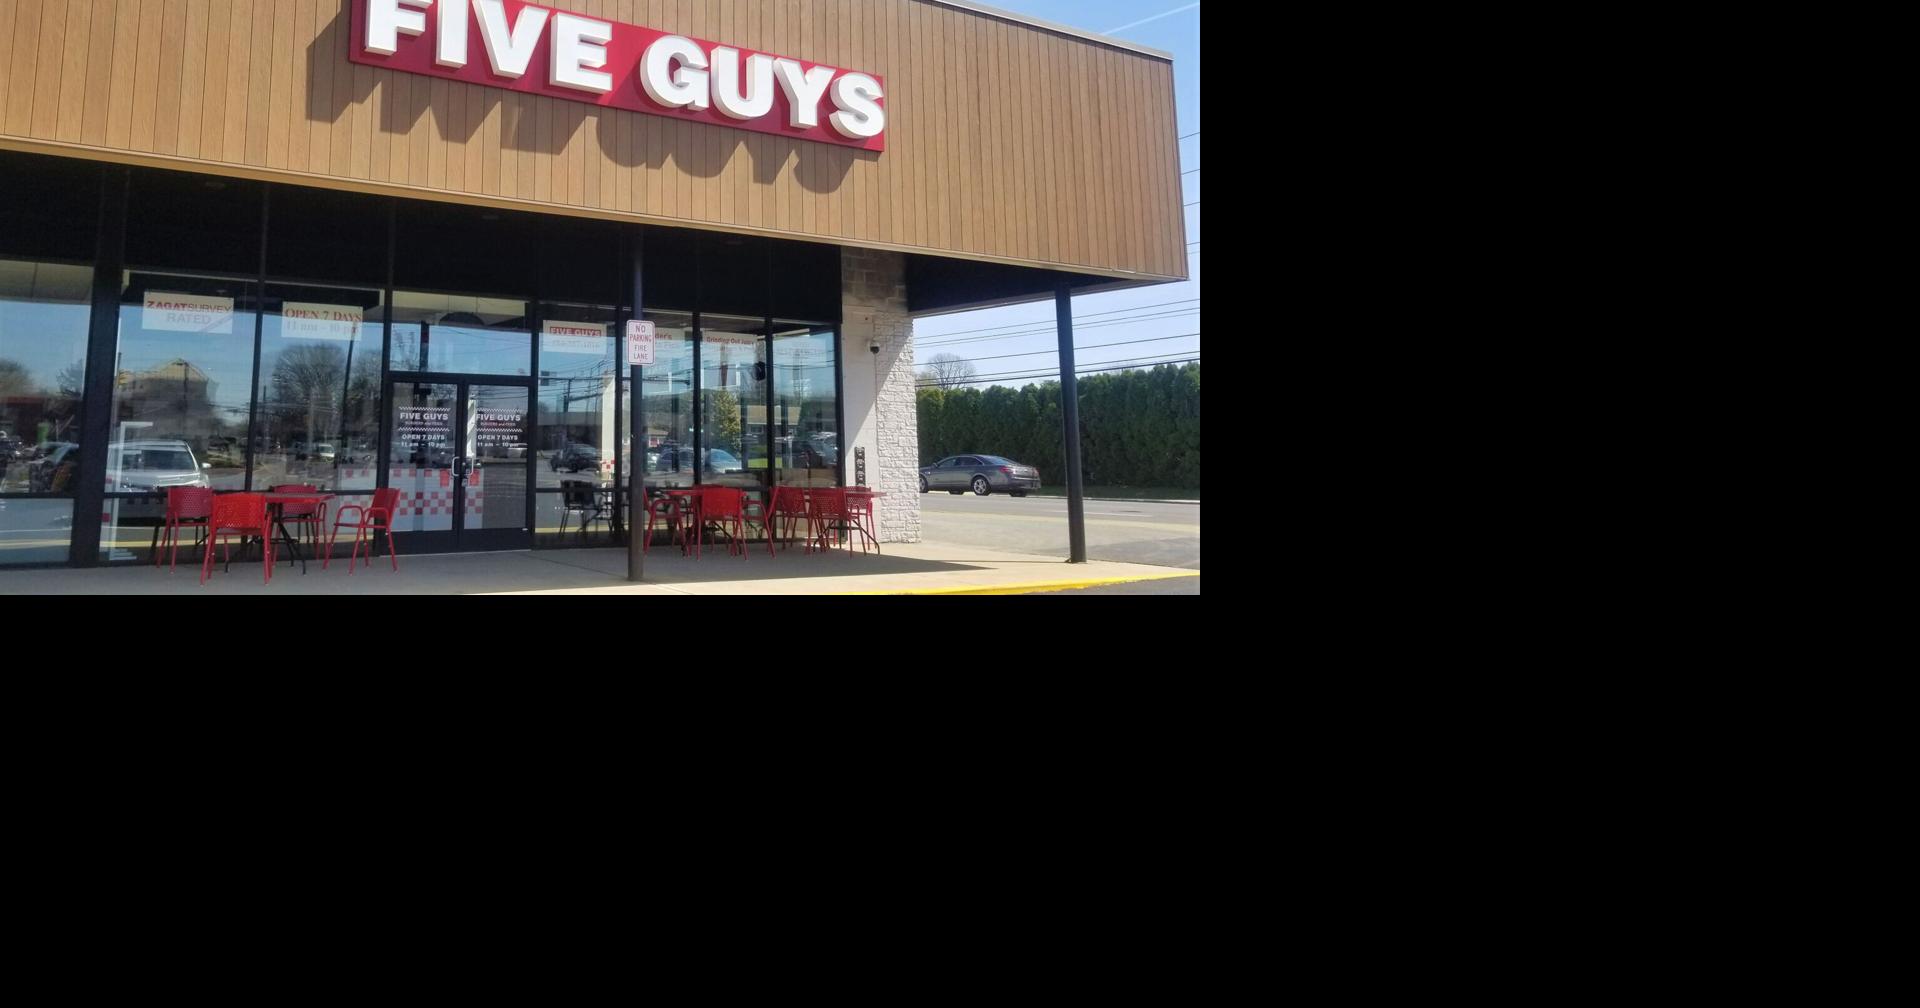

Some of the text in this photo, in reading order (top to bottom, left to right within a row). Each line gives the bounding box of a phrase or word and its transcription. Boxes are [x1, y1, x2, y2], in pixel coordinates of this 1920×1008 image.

[365, 0, 886, 139] FIVE GUYS
[167, 312, 211, 324] RATED
[285, 308, 361, 322] OPEN 7 DAYS
[551, 327, 572, 335] FIVE
[635, 325, 646, 333] NO
[629, 334, 652, 342] PARKING
[400, 412, 420, 420] FIVE
[476, 413, 521, 422] FIVE GUYS
